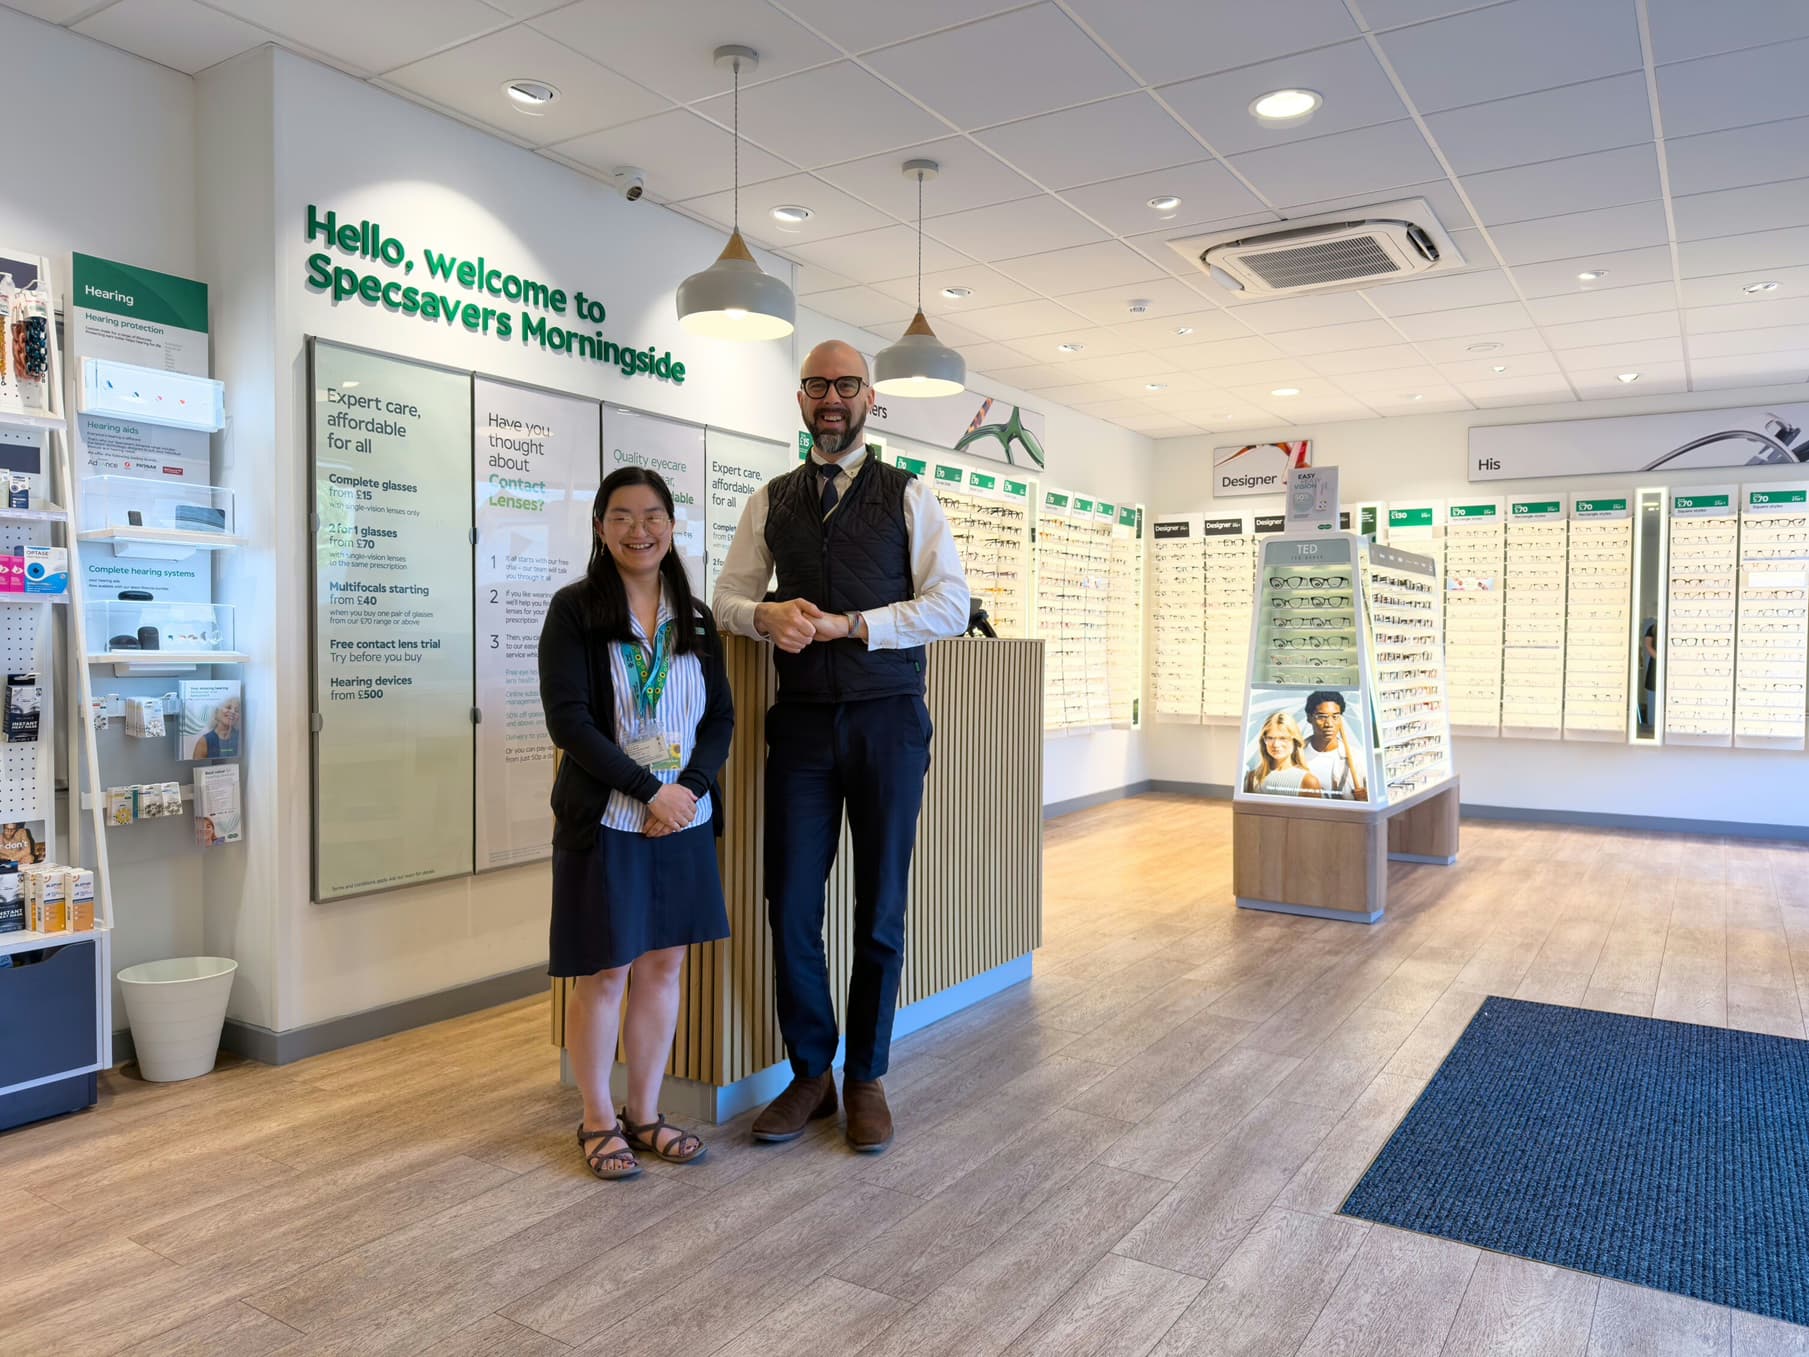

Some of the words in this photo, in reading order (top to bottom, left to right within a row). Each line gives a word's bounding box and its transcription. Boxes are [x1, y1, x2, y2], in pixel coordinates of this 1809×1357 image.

[307, 204, 415, 275] Hello,
[423, 249, 567, 312] welcome
[575, 292, 606, 323] to
[85, 285, 134, 307] Hearing
[85, 311, 119, 328] Hearing
[120, 320, 164, 336] protection
[308, 253, 512, 337] Specsavers
[522, 312, 686, 382] Morningside
[327, 388, 382, 412] Expert
[386, 401, 421, 420] care,
[87, 420, 120, 434] Hearing
[122, 425, 138, 434] aids
[327, 411, 407, 438] affordable
[488, 412, 522, 433] Have
[525, 422, 551, 438] you
[327, 432, 352, 451] for
[355, 438, 372, 454] all
[489, 432, 545, 457] thought
[488, 452, 531, 473] about
[613, 448, 649, 468] Quality
[651, 457, 687, 473] eyecare
[1477, 457, 1502, 472] His
[712, 460, 742, 477] Expert
[743, 468, 762, 480] care,
[329, 473, 380, 489] Complete
[382, 480, 418, 494] glasses
[488, 473, 547, 495] Contact
[711, 478, 755, 495] affordable
[1222, 474, 1278, 490] Designer
[329, 487, 353, 497] from
[356, 489, 372, 500] £15
[712, 493, 724, 505] for
[727, 496, 736, 507] all
[1752, 495, 1768, 503] £70
[489, 493, 545, 512] Lenses?
[1514, 505, 1528, 513] £70
[1578, 502, 1592, 511] £70
[1677, 499, 1692, 507] £70
[387, 507, 405, 515] lenses
[1155, 525, 1179, 533] Designer
[1206, 521, 1231, 530] Designer
[1256, 518, 1282, 527] Designer
[354, 526, 358, 535] 1
[361, 526, 397, 538] glasses
[329, 536, 353, 547] from
[356, 540, 374, 549] £70
[1296, 544, 1317, 554] TED
[387, 554, 405, 563] lenses
[490, 554, 496, 569] 1
[88, 565, 129, 574] Complete
[131, 568, 161, 577] hearing
[163, 569, 194, 577] systems
[370, 561, 407, 570] prescription
[329, 582, 386, 592] Multifocals
[389, 585, 428, 596] starting
[329, 594, 354, 604] from
[357, 596, 376, 605] £40
[489, 588, 499, 605] 2
[412, 611, 433, 619] glasses
[505, 617, 537, 625] prescription
[373, 618, 390, 626] range
[330, 640, 353, 648] Free
[356, 640, 395, 648] contact
[398, 639, 417, 648] lens
[420, 639, 440, 648] trial
[490, 634, 500, 650] 3
[330, 652, 346, 663] Try
[349, 651, 381, 661] before
[384, 653, 401, 663] you
[404, 652, 421, 663] buy
[330, 676, 372, 688] Hearing
[375, 675, 412, 685] devices
[330, 690, 354, 700] from
[357, 689, 383, 699] £500
[4, 840, 27, 849] don't
